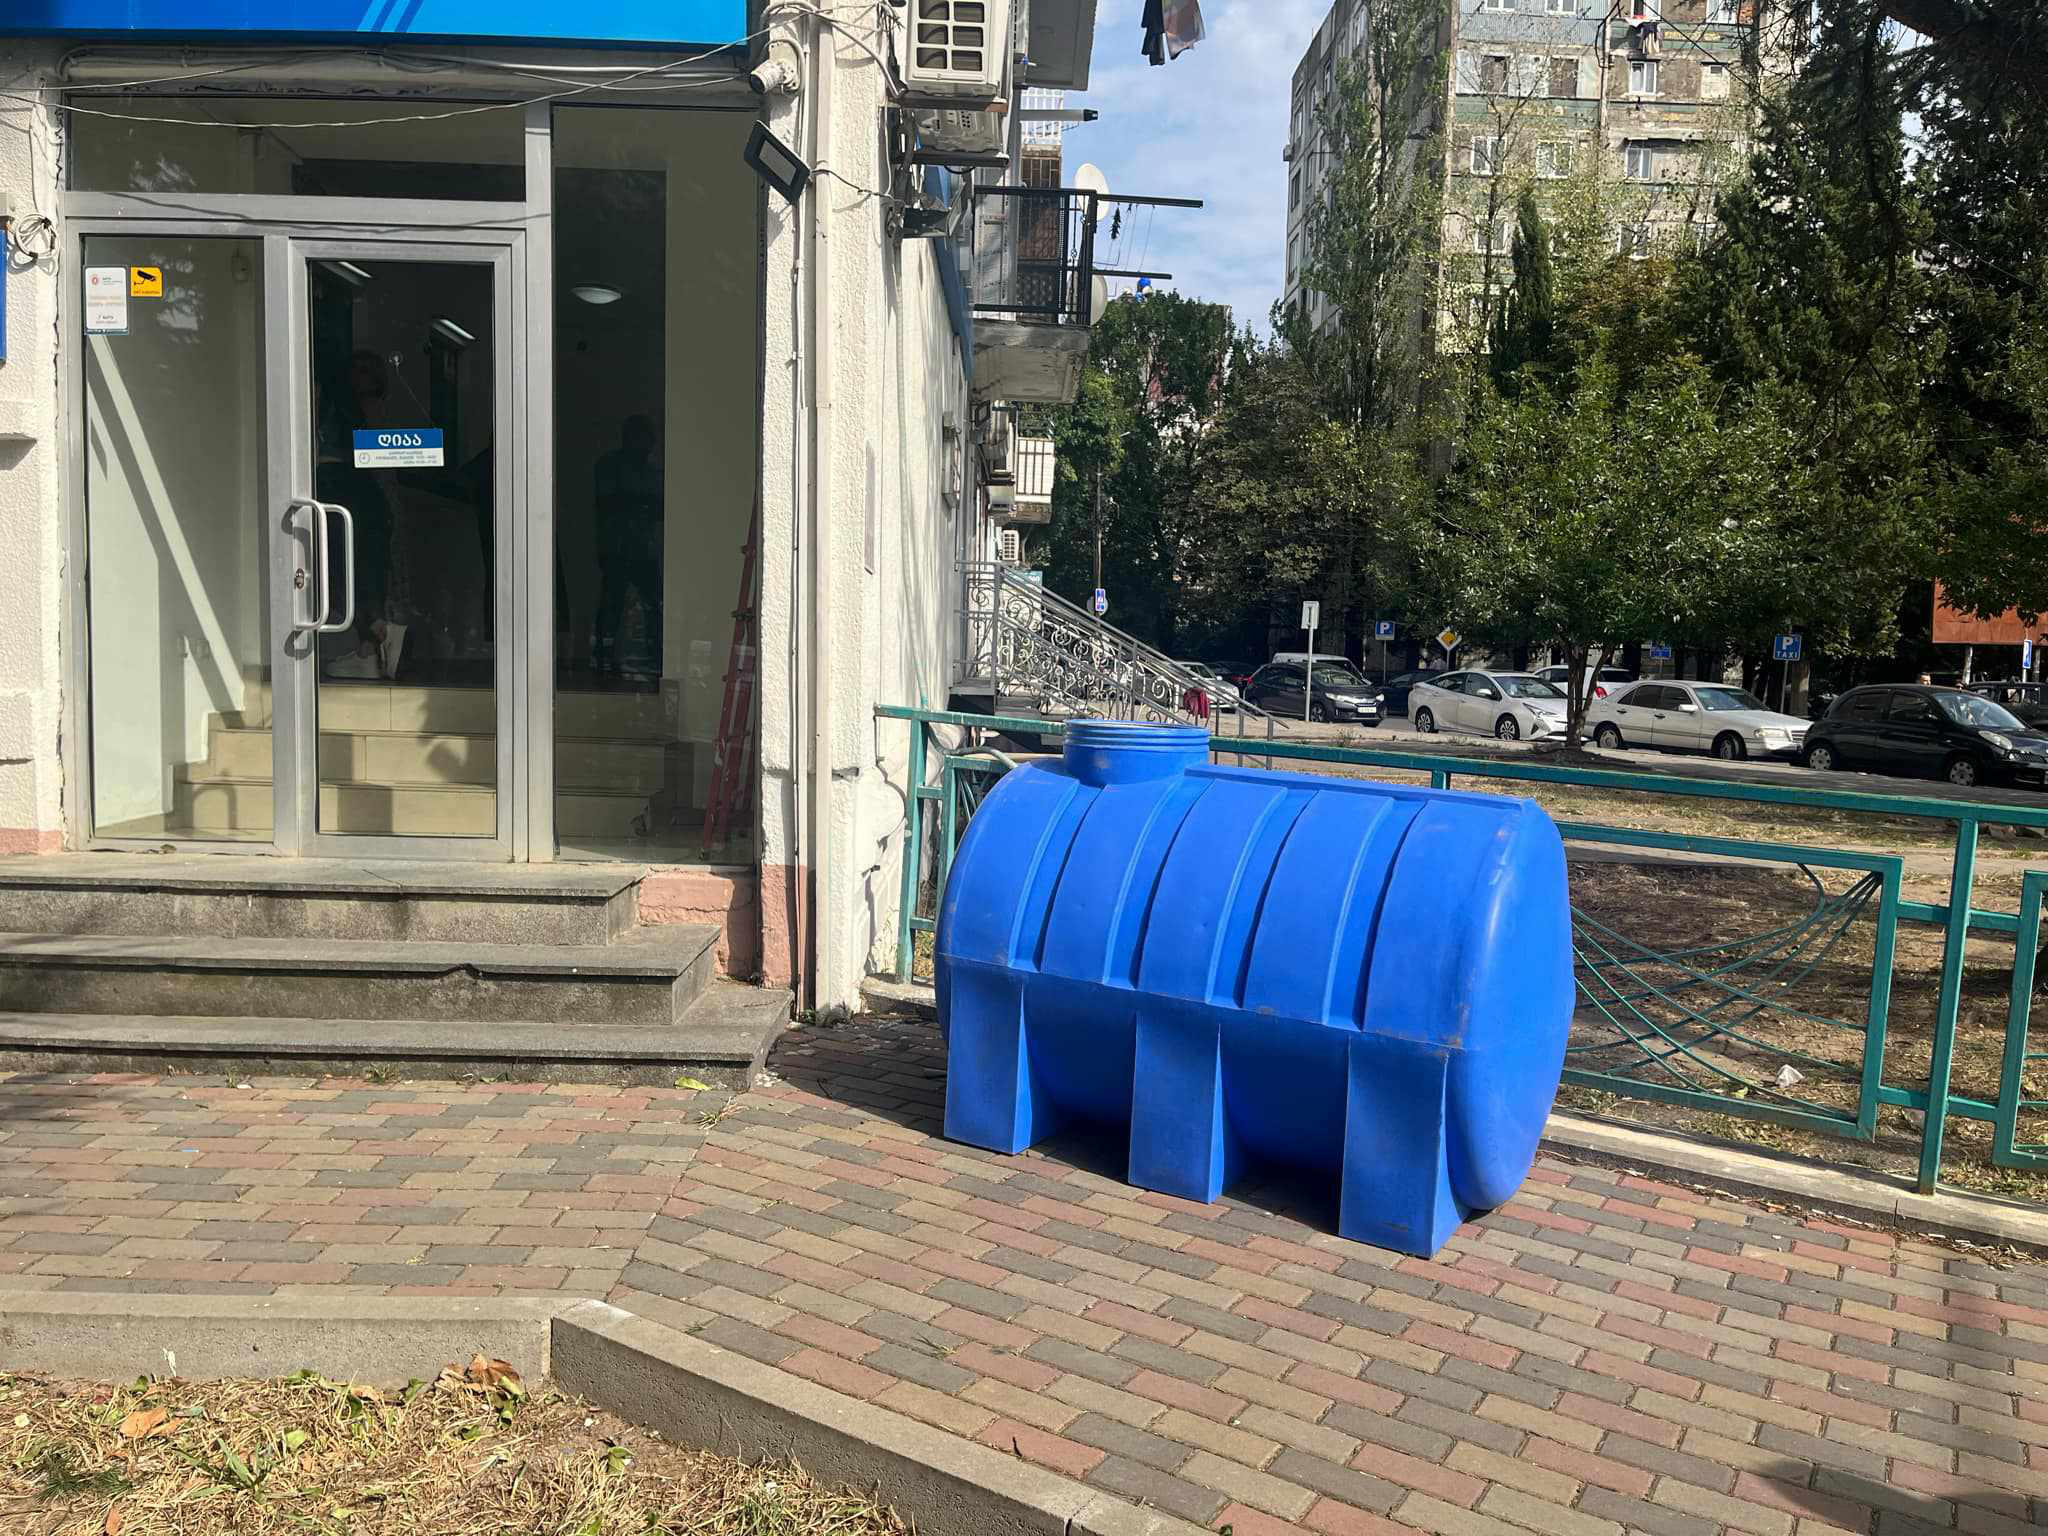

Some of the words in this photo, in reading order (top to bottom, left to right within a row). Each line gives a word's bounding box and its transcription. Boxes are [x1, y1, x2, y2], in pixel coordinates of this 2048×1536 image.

[378, 434, 421, 446] ღიაა
[1380, 622, 1390, 634] P
[1782, 636, 1793, 650] P
